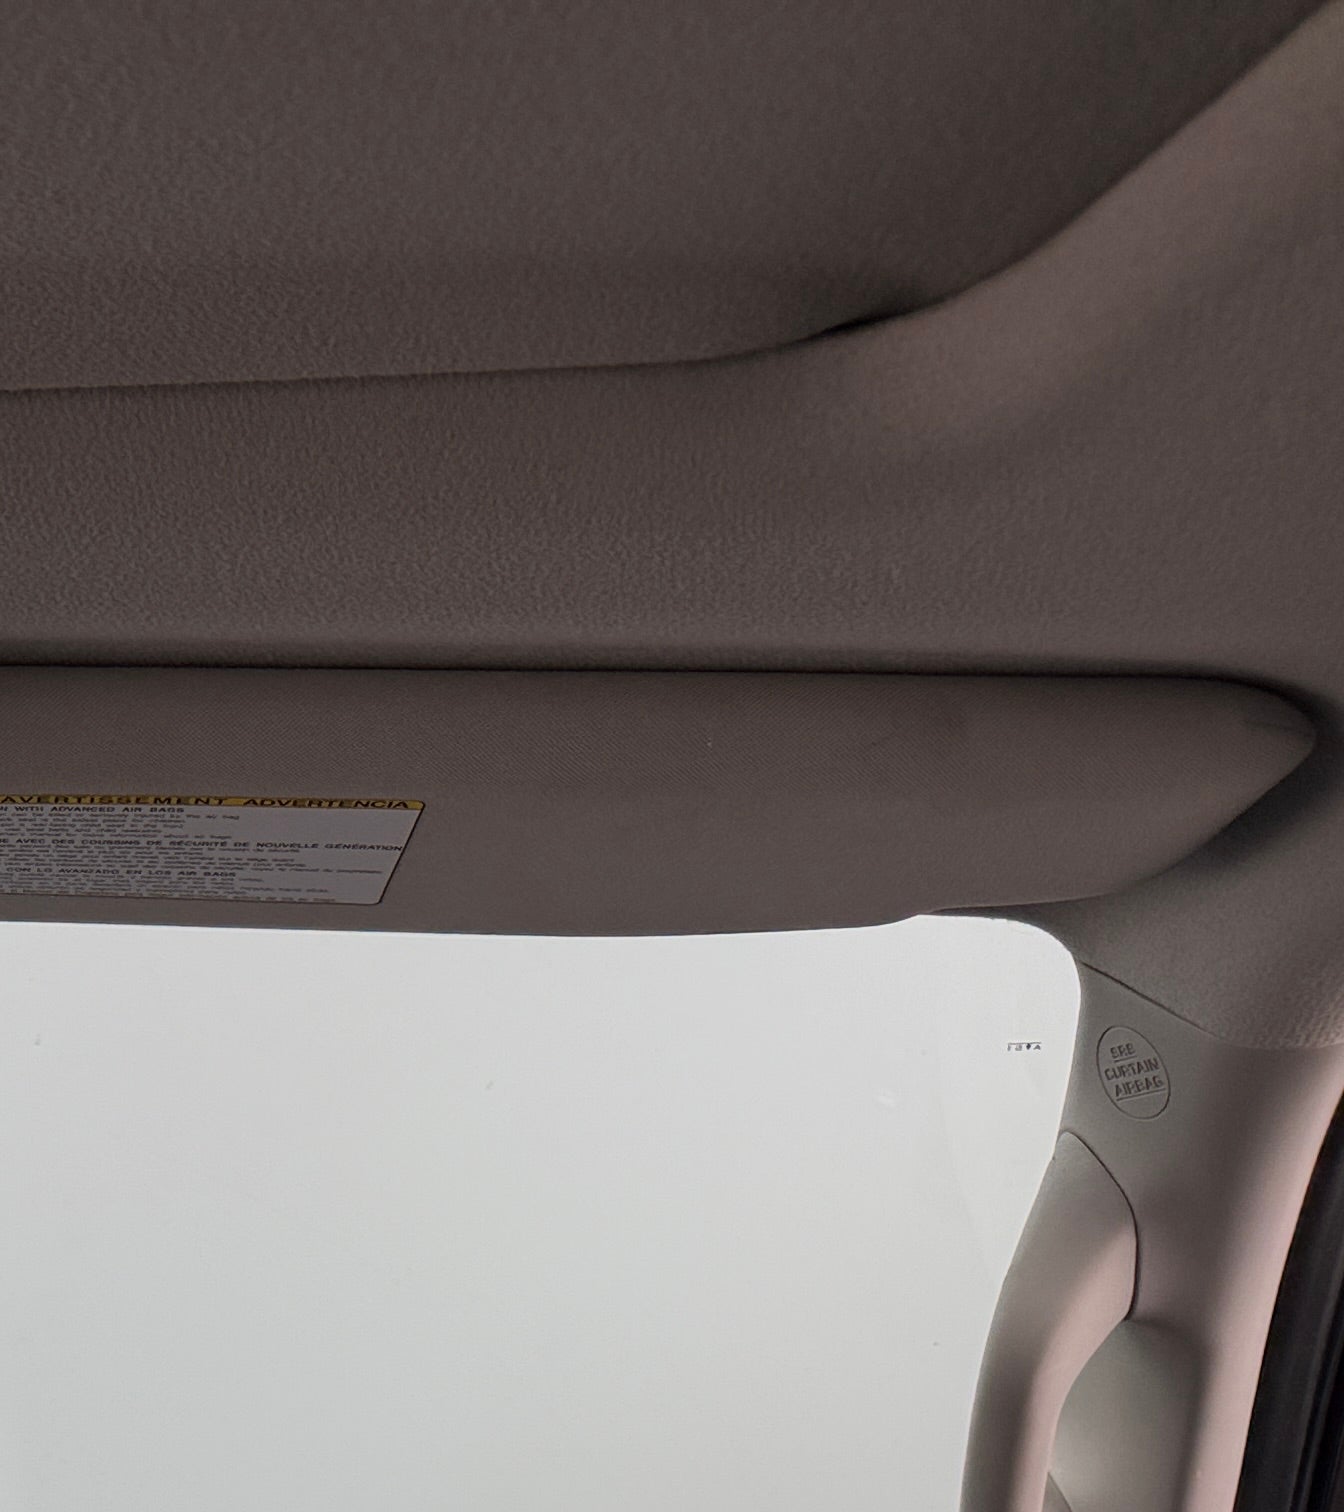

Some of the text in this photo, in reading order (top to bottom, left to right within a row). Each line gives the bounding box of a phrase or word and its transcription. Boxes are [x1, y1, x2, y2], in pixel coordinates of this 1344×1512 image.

[0, 795, 227, 806] AVERTISSEMENT
[242, 798, 410, 809] ADVERTENCIA
[1104, 1057, 1160, 1081] CURTAIN
[1115, 1075, 1163, 1097] AIRBAG
